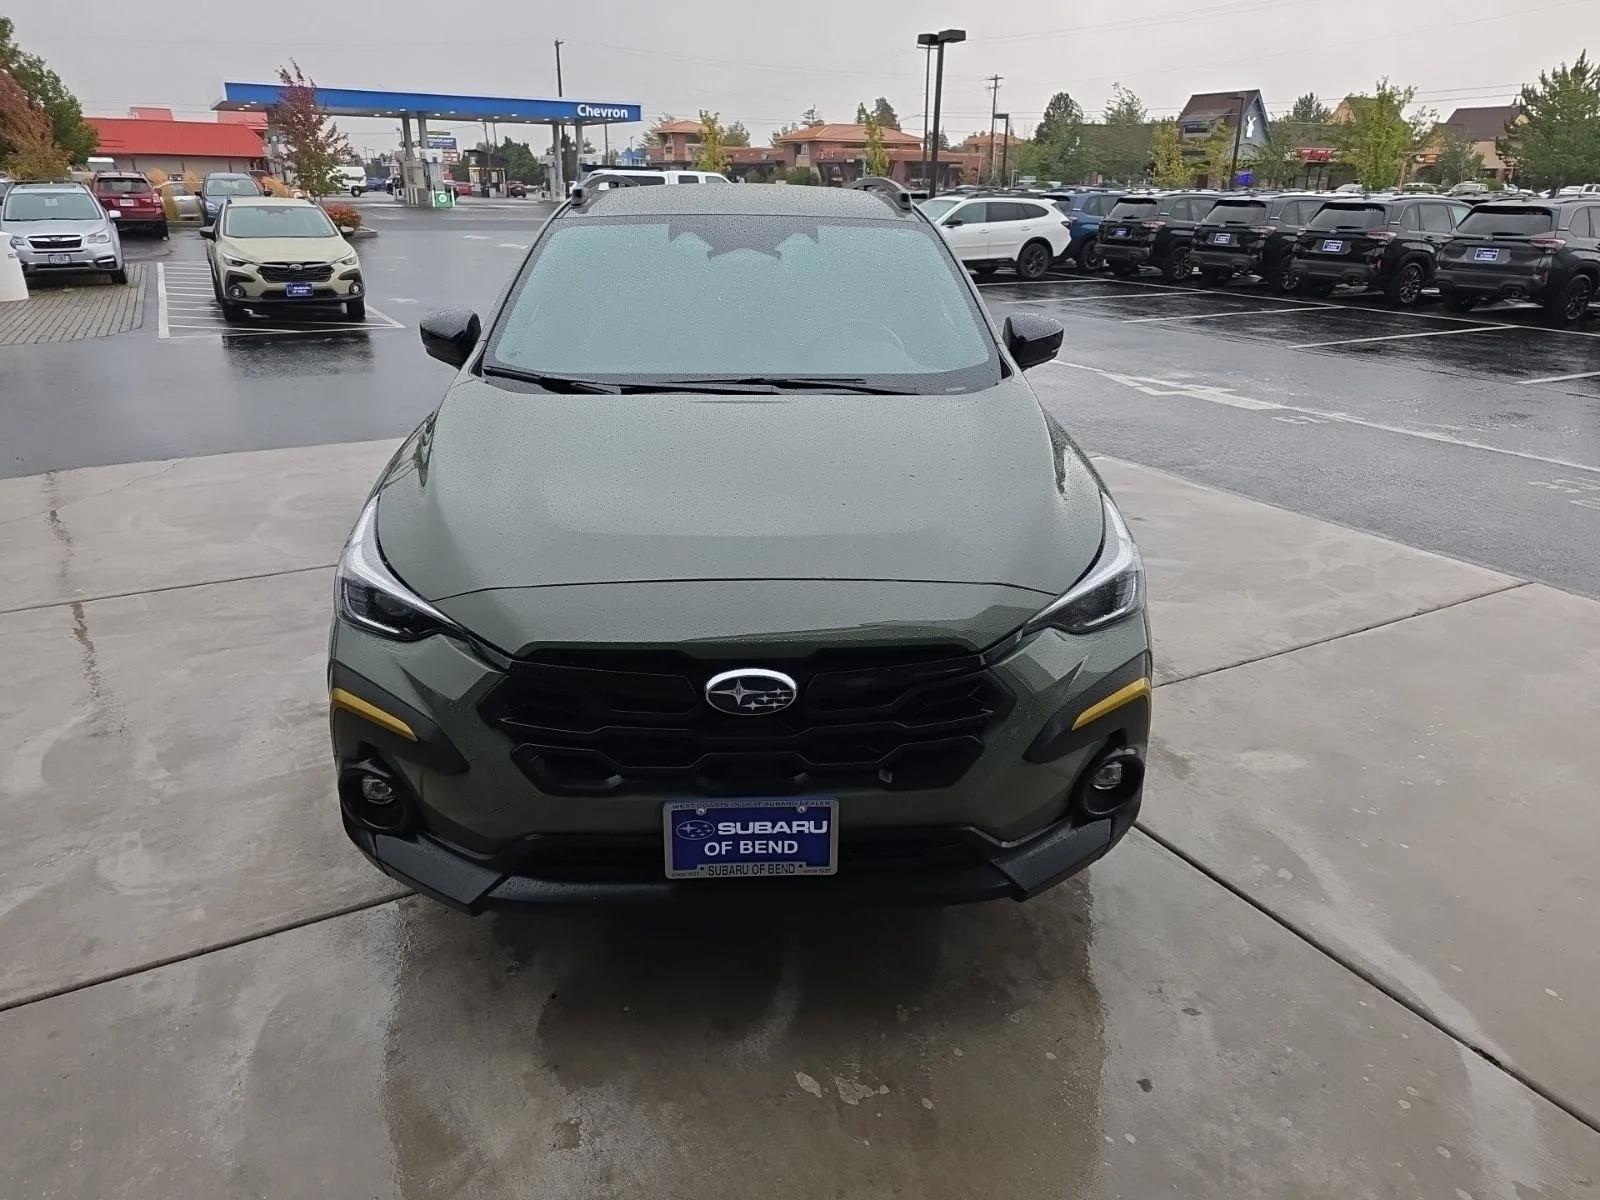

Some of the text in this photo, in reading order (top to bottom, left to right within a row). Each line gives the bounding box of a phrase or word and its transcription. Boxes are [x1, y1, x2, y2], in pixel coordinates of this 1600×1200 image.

[577, 104, 628, 118] Chevron
[717, 820, 828, 835] SUBARU
[704, 840, 799, 856] OF BEND
[708, 863, 796, 876] SUBARU OF BEND
